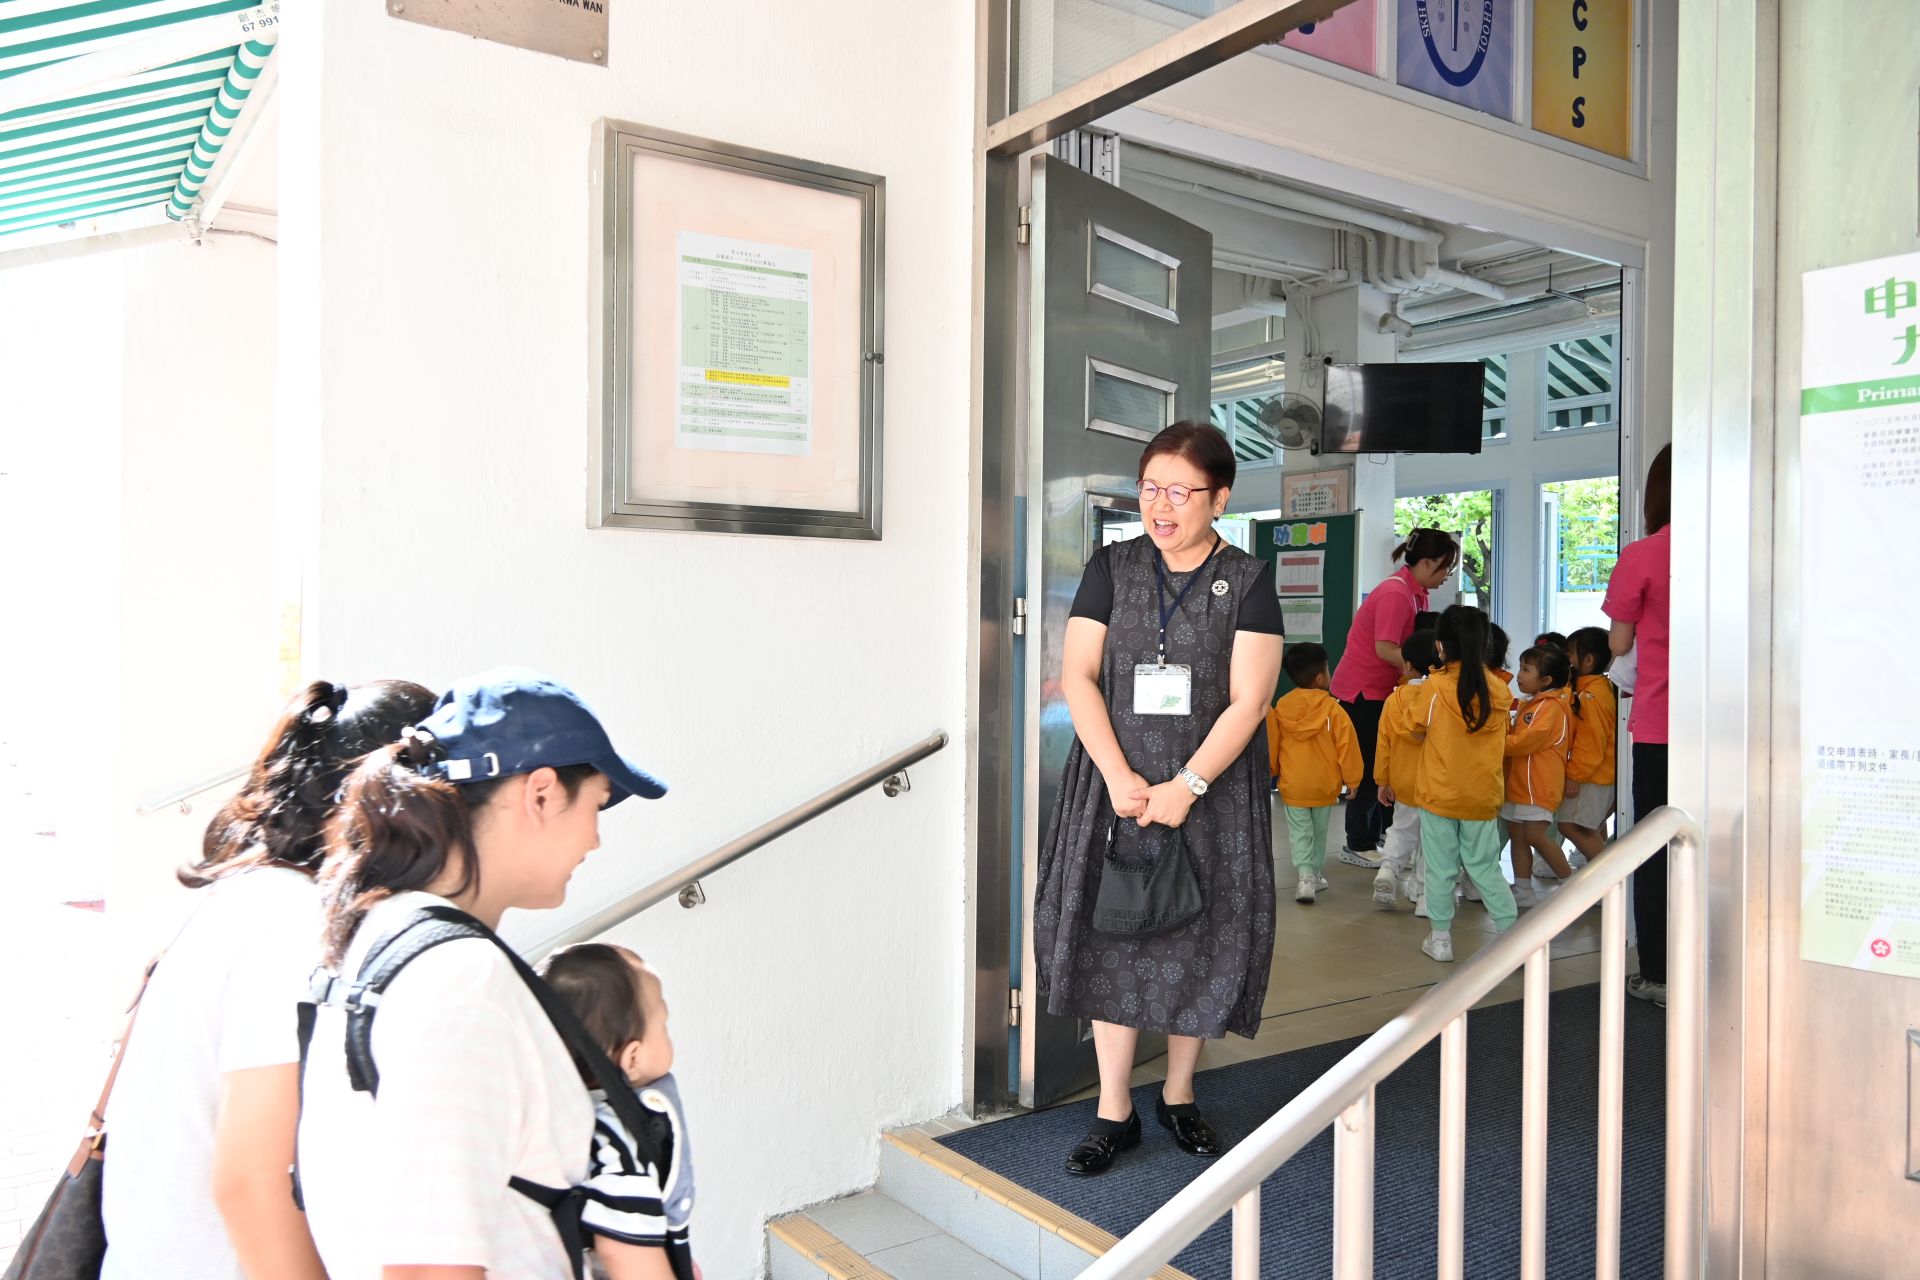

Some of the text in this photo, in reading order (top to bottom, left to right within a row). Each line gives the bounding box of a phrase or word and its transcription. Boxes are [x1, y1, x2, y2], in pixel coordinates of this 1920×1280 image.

[583, 0, 602, 14] WAN
[242, 22, 255, 32] 67
[1418, 7, 1431, 37] SKH
[1864, 277, 1917, 319] 申
[1857, 386, 1920, 402] Prima
